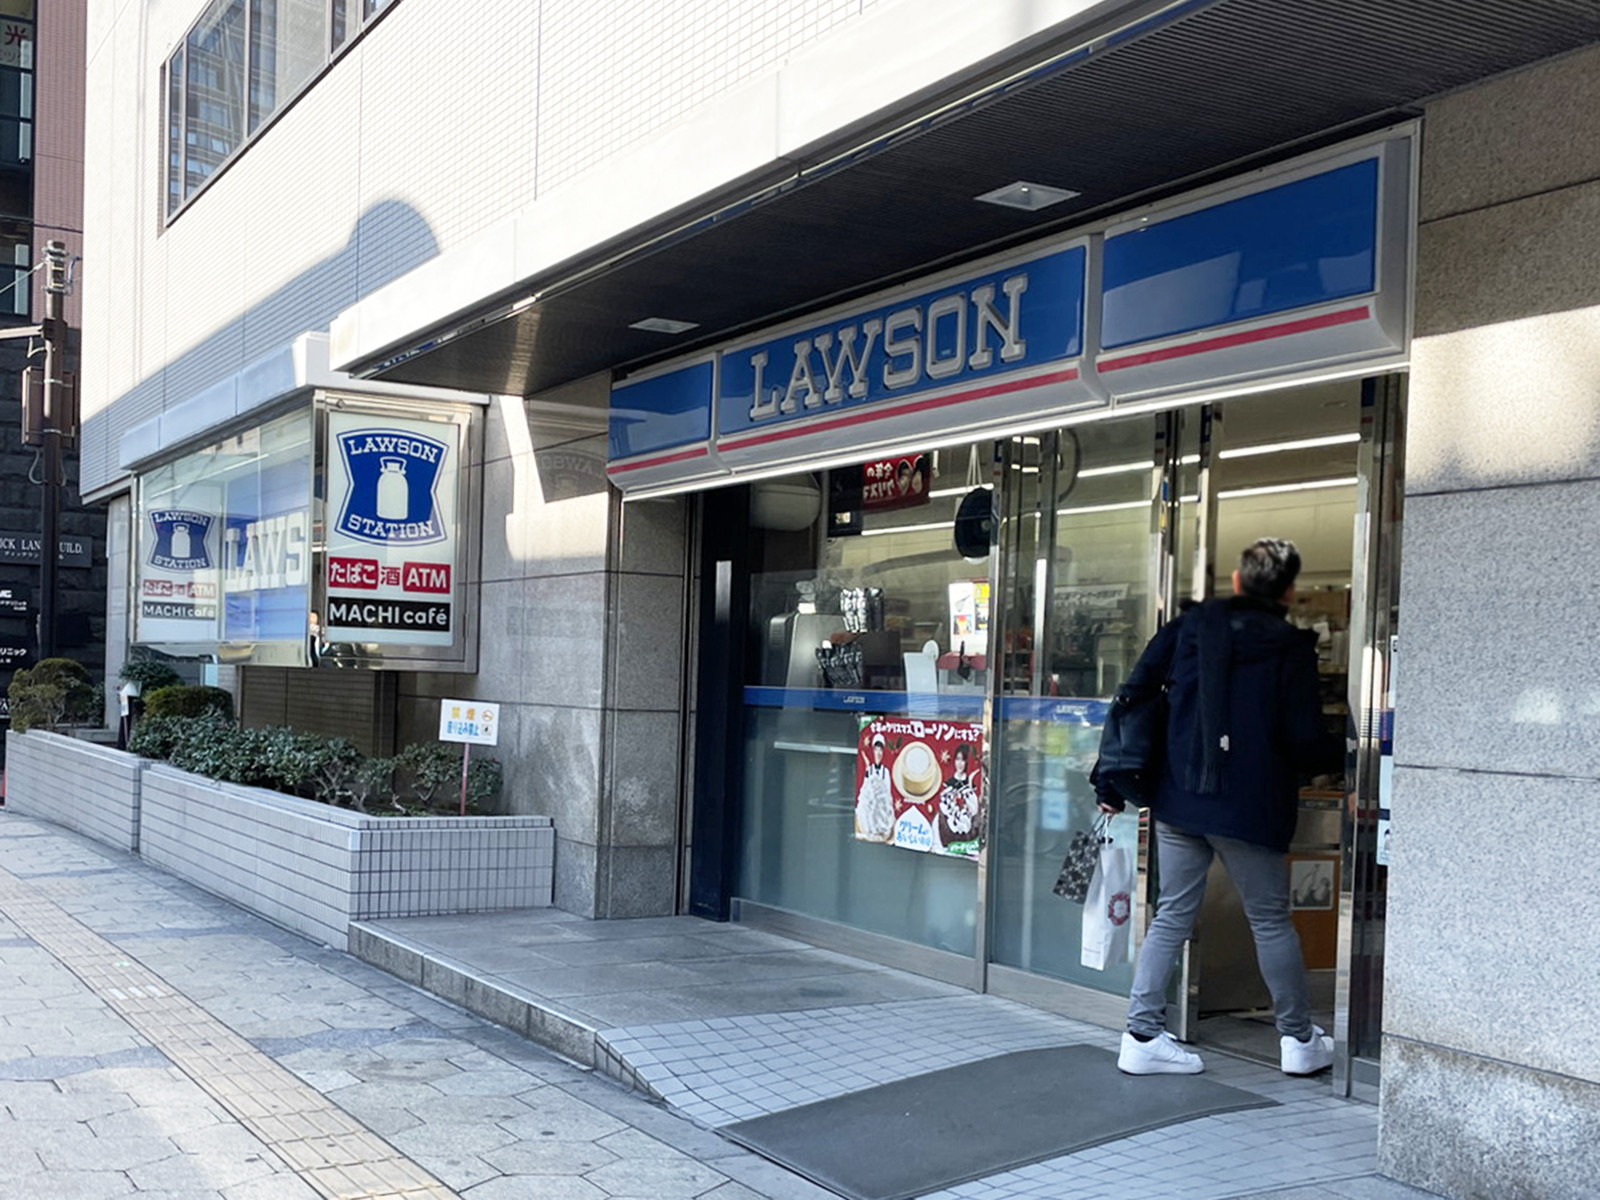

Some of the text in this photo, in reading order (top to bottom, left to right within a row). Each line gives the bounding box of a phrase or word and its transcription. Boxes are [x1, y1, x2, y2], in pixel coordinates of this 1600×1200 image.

[749, 273, 1028, 421] LAWSON
[348, 436, 438, 464] LAWSON
[154, 511, 209, 527] LAWSON
[347, 514, 436, 539] STATION
[21, 539, 41, 551] LAN
[59, 541, 84, 554] UILD.
[224, 511, 309, 593] LAWS
[153, 555, 208, 570] STATION
[330, 561, 447, 589] たばこ 酒 ATM
[143, 604, 187, 618] MACHI
[329, 603, 448, 625] MACHI café
